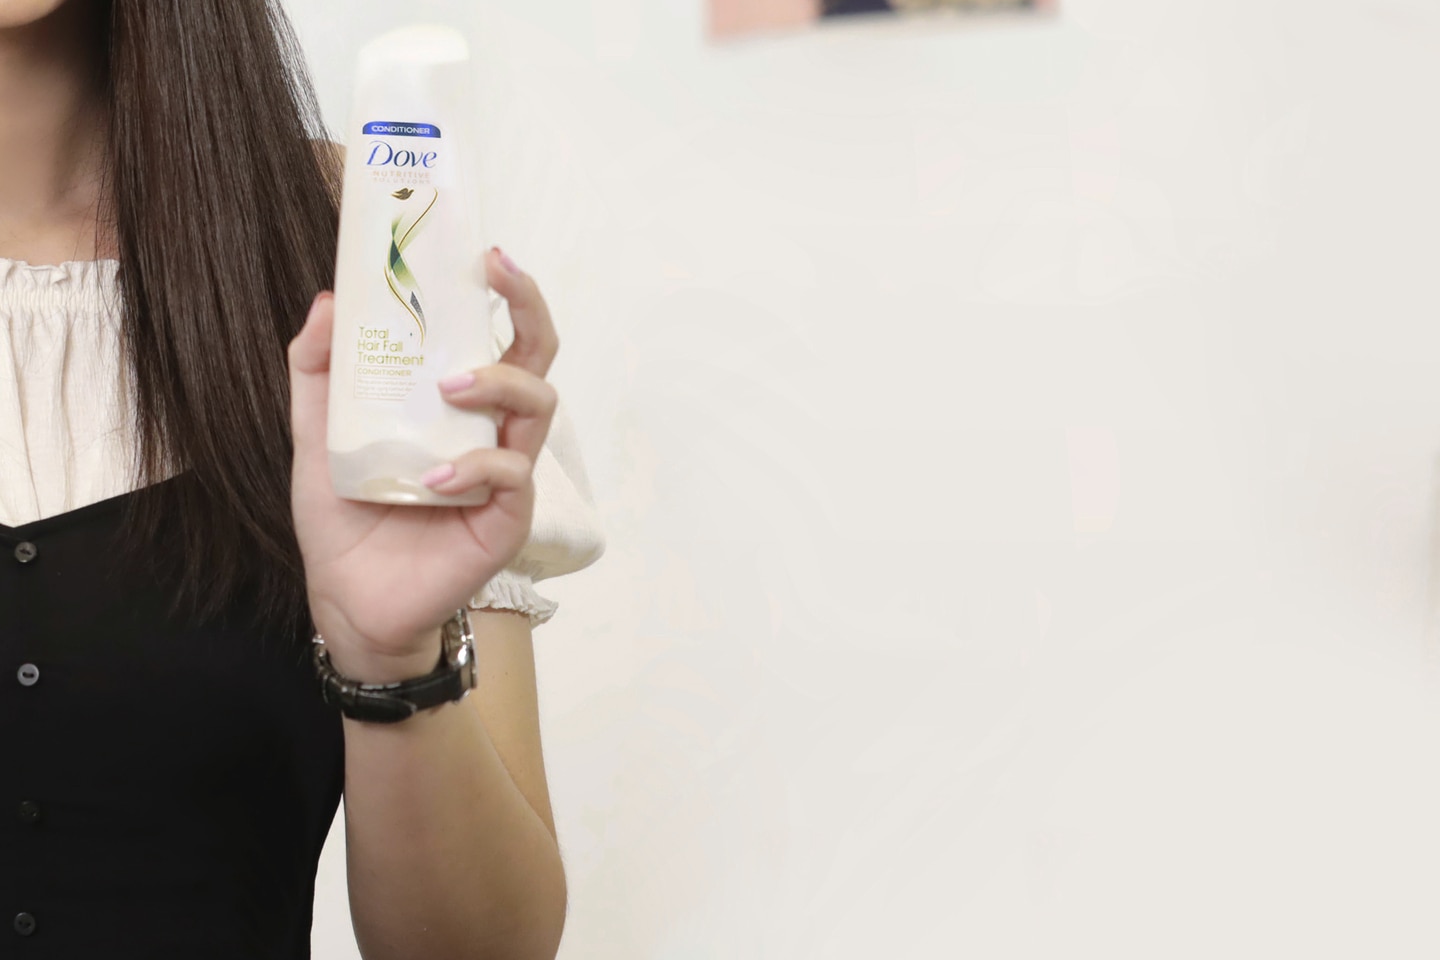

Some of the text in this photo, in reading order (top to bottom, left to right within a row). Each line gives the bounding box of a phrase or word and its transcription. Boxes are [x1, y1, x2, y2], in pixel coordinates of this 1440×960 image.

[372, 126, 430, 134] CONDITIONER
[366, 140, 437, 169] Dove
[359, 326, 389, 339] Total
[357, 339, 403, 352] Hair Fall
[358, 352, 424, 365] Treatment
[358, 368, 411, 376] CONDITIONER
